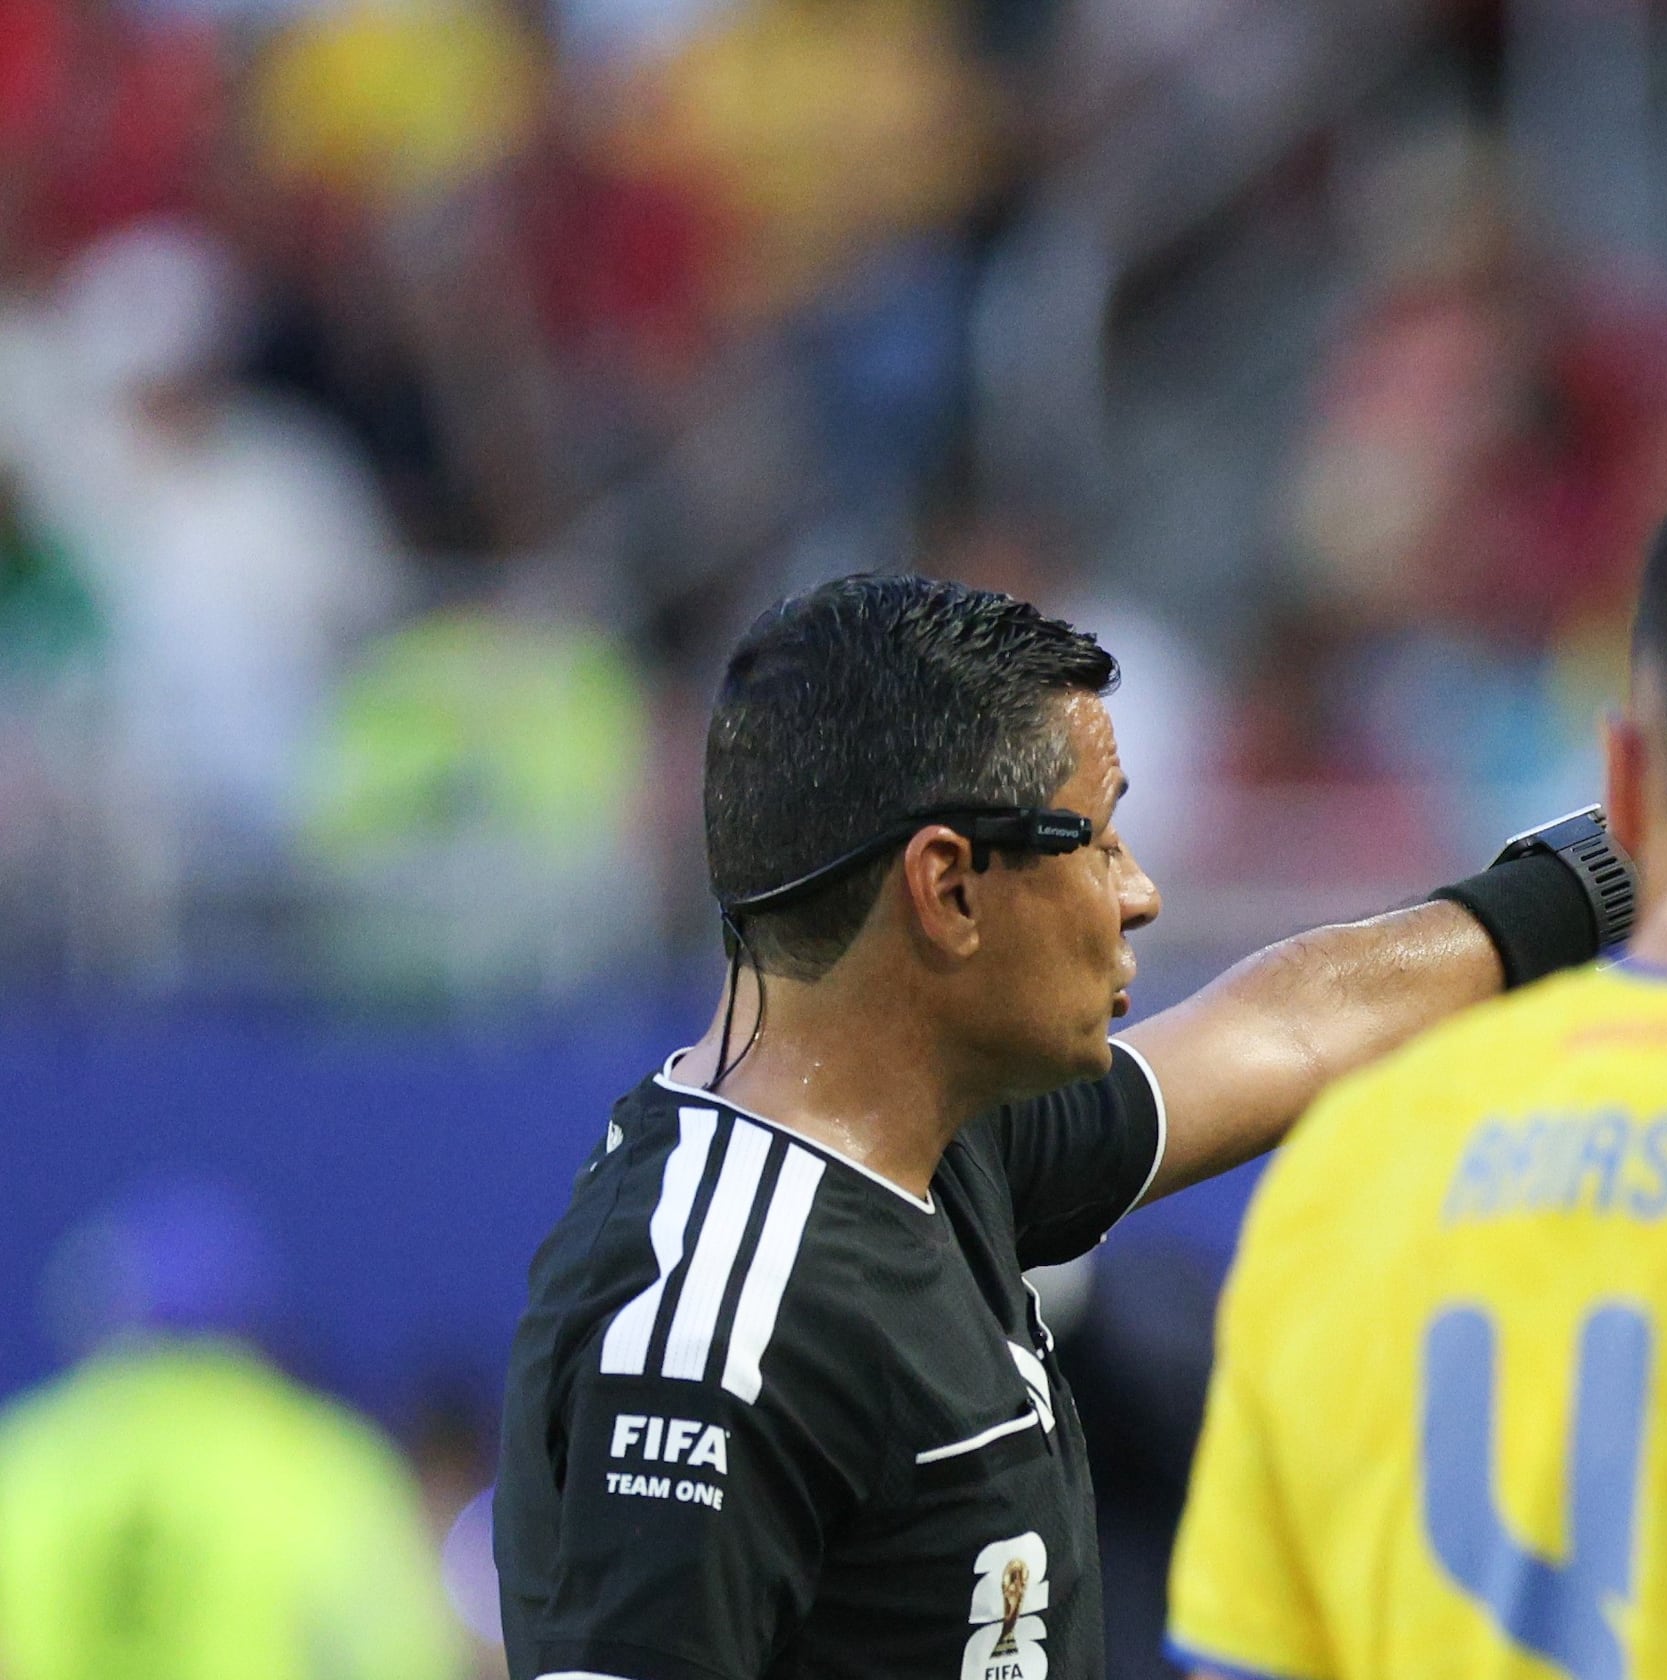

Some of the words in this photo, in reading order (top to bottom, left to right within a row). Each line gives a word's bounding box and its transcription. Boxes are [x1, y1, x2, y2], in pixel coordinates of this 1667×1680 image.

[1038, 825, 1079, 838] Lenovo
[610, 1414, 728, 1475] FIFA
[606, 1473, 671, 1499] TEAM
[675, 1481, 724, 1511] ONE
